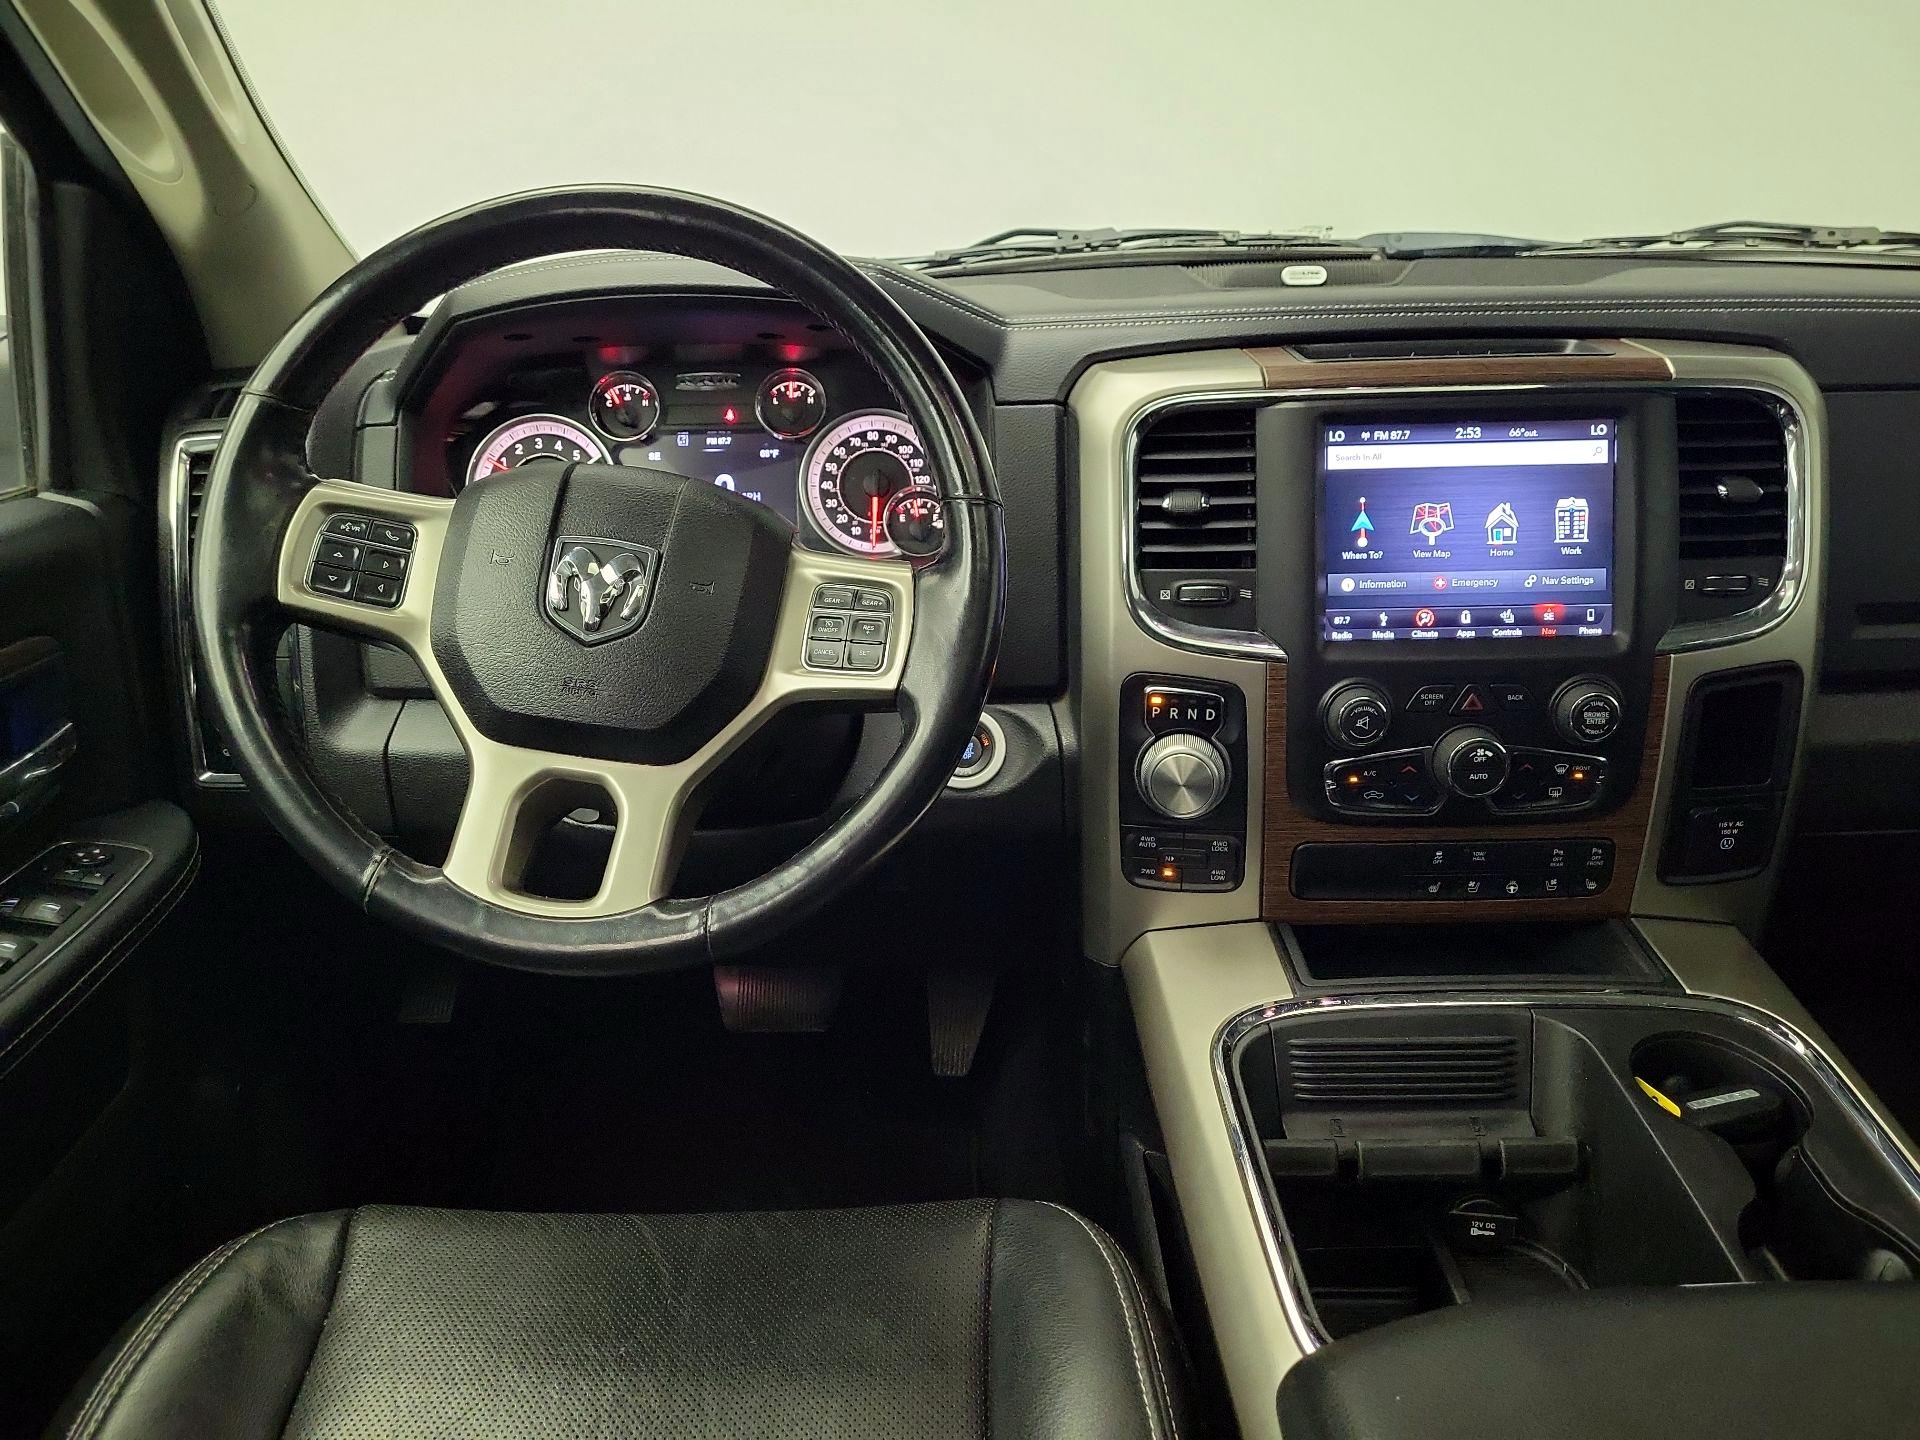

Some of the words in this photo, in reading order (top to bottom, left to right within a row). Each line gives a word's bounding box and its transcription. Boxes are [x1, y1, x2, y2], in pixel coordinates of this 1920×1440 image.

[1455, 427, 1481, 438] 2:53
[1590, 424, 1607, 436] LO
[867, 431, 879, 440] 80
[885, 435, 898, 444] 90
[1328, 430, 1345, 442] LO
[1374, 431, 1388, 440] FM
[1390, 430, 1410, 440] 87.7
[534, 438, 543, 449] 3
[554, 440, 564, 451] 4
[849, 437, 861, 446] 70
[515, 444, 523, 454] 2
[833, 446, 845, 456] 60
[898, 445, 914, 454] 100
[573, 450, 580, 461] 5
[500, 457, 507, 467] 1
[825, 462, 837, 471] 50
[909, 458, 924, 468] 110
[914, 475, 930, 484] 120
[820, 481, 834, 490] 40
[826, 499, 838, 508] 30
[836, 514, 848, 524] 20
[899, 514, 906, 522] E
[851, 527, 862, 536] 10
[1433, 549, 1451, 559] Map
[1490, 548, 1514, 556] Home
[1560, 546, 1582, 555] Work
[1342, 551, 1367, 560] Where
[1369, 551, 1383, 559] To?
[1360, 580, 1407, 588] Information
[1452, 578, 1498, 587] Emergency
[1542, 576, 1559, 585] Nav
[1561, 575, 1594, 586] Settings
[1334, 616, 1350, 624] 87.7
[1492, 628, 1522, 636] Controls
[1578, 626, 1602, 635] Phone
[1332, 631, 1352, 640] Radio
[1152, 707, 1160, 718] P
[1170, 708, 1178, 719] R
[1188, 708, 1197, 720] N
[1206, 709, 1216, 720] D
